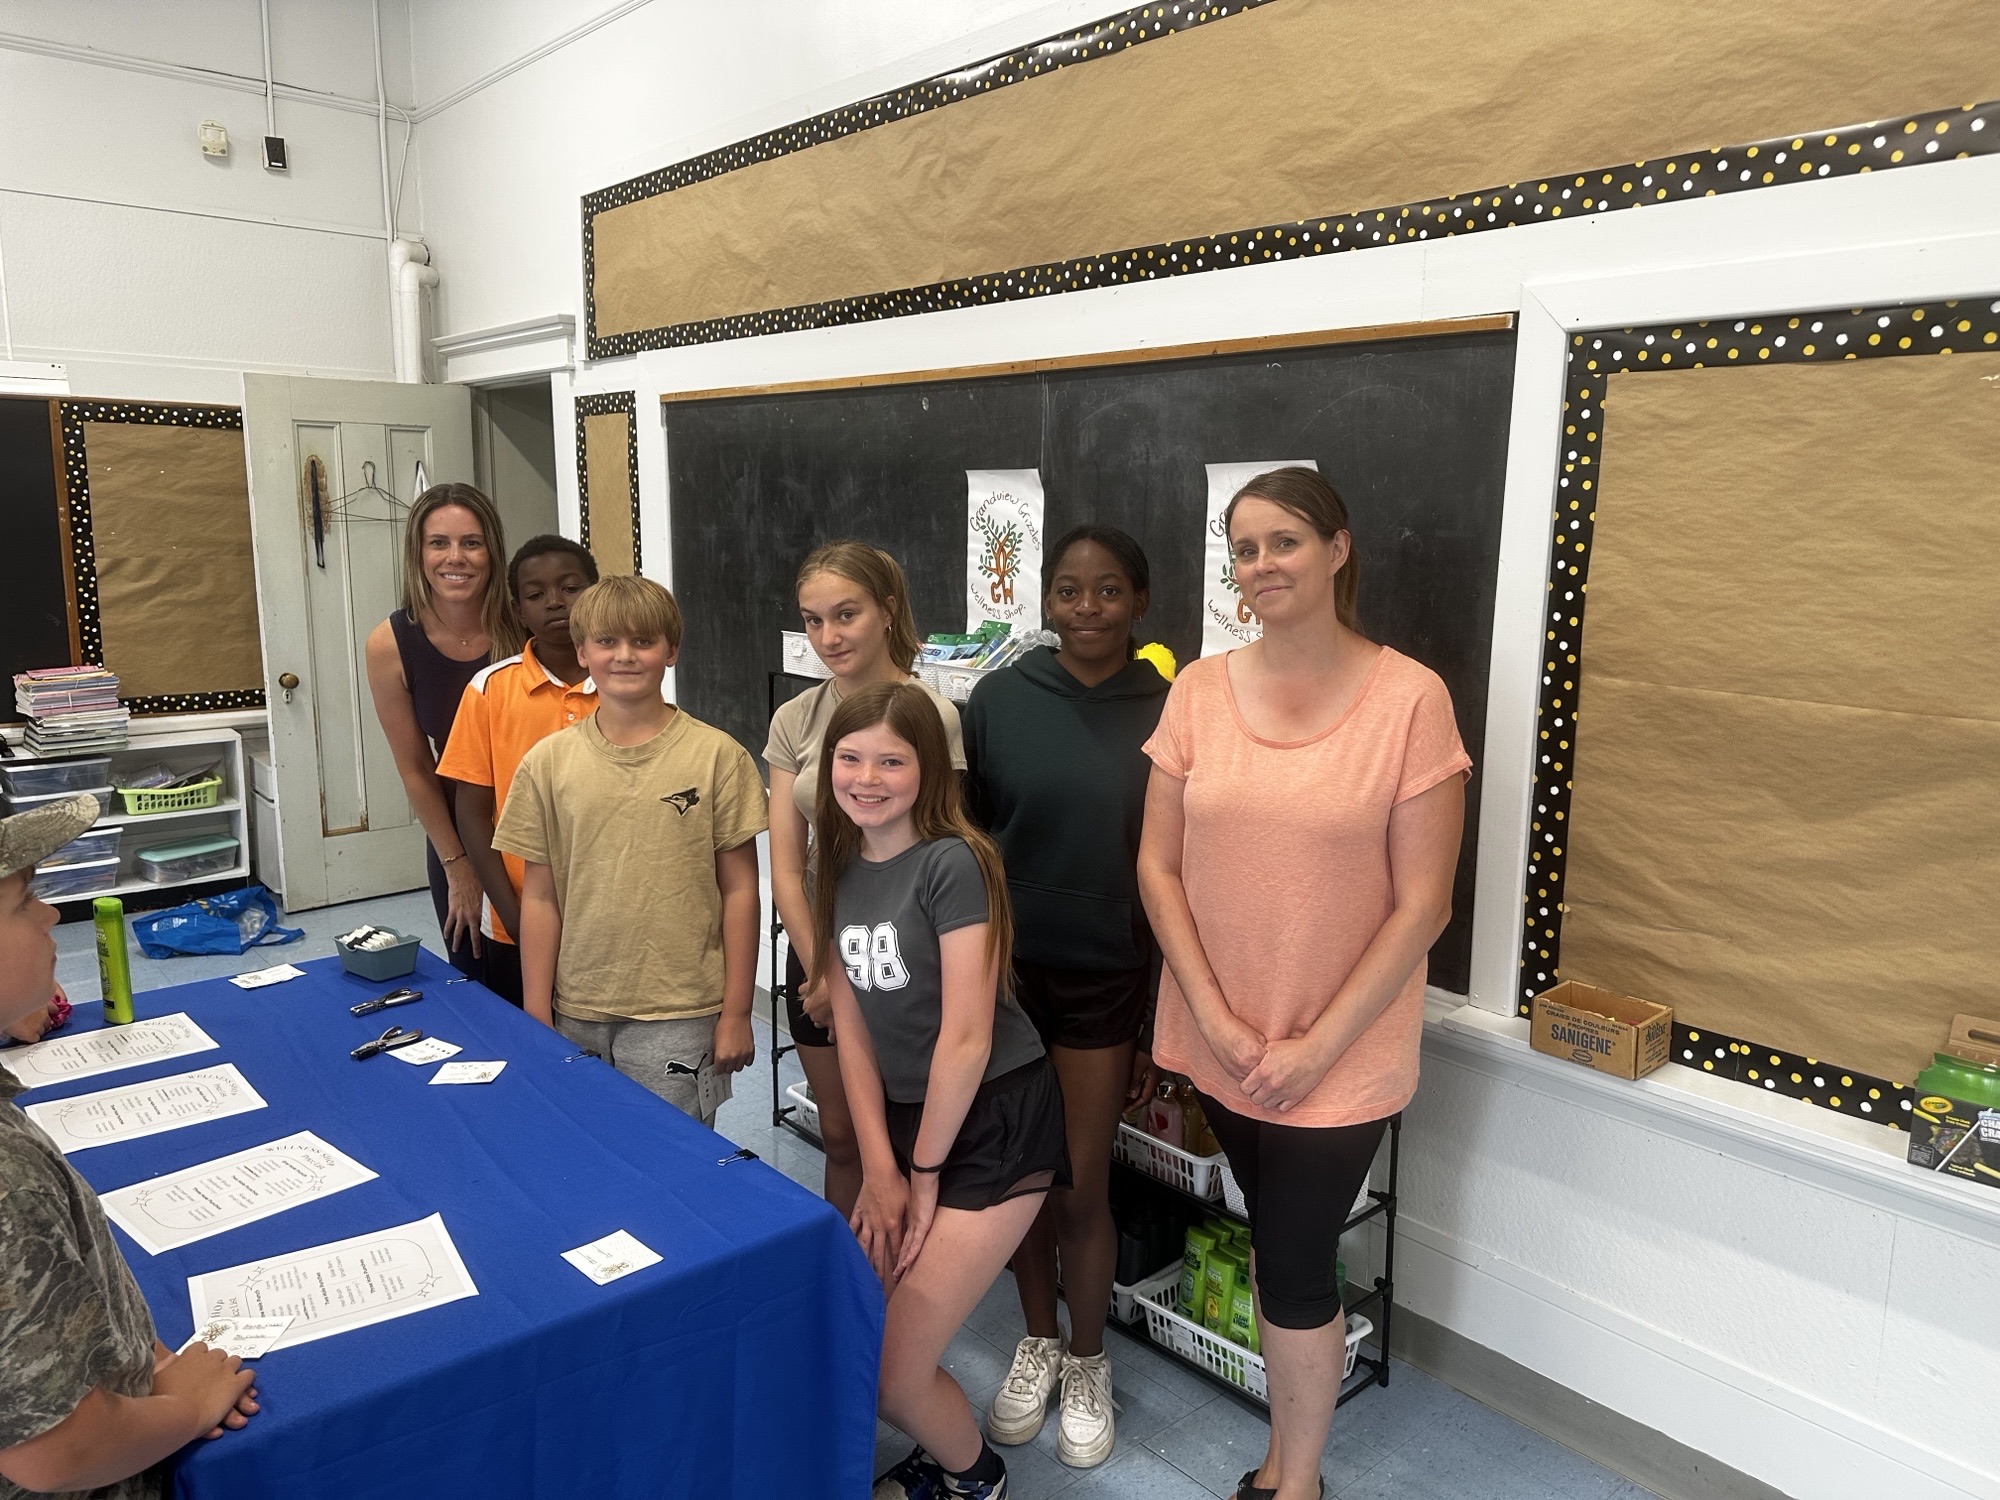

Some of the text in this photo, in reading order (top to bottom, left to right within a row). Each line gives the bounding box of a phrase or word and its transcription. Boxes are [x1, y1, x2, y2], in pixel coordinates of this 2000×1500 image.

[970, 491, 1042, 551] Grandview Grizzles
[839, 921, 911, 992] 98
[1546, 1009, 1570, 1020] CRAIES
[1583, 1020, 1620, 1036] COULEURS
[1567, 1022, 1599, 1036] PROPRES
[211, 1299, 224, 1318] HOP
